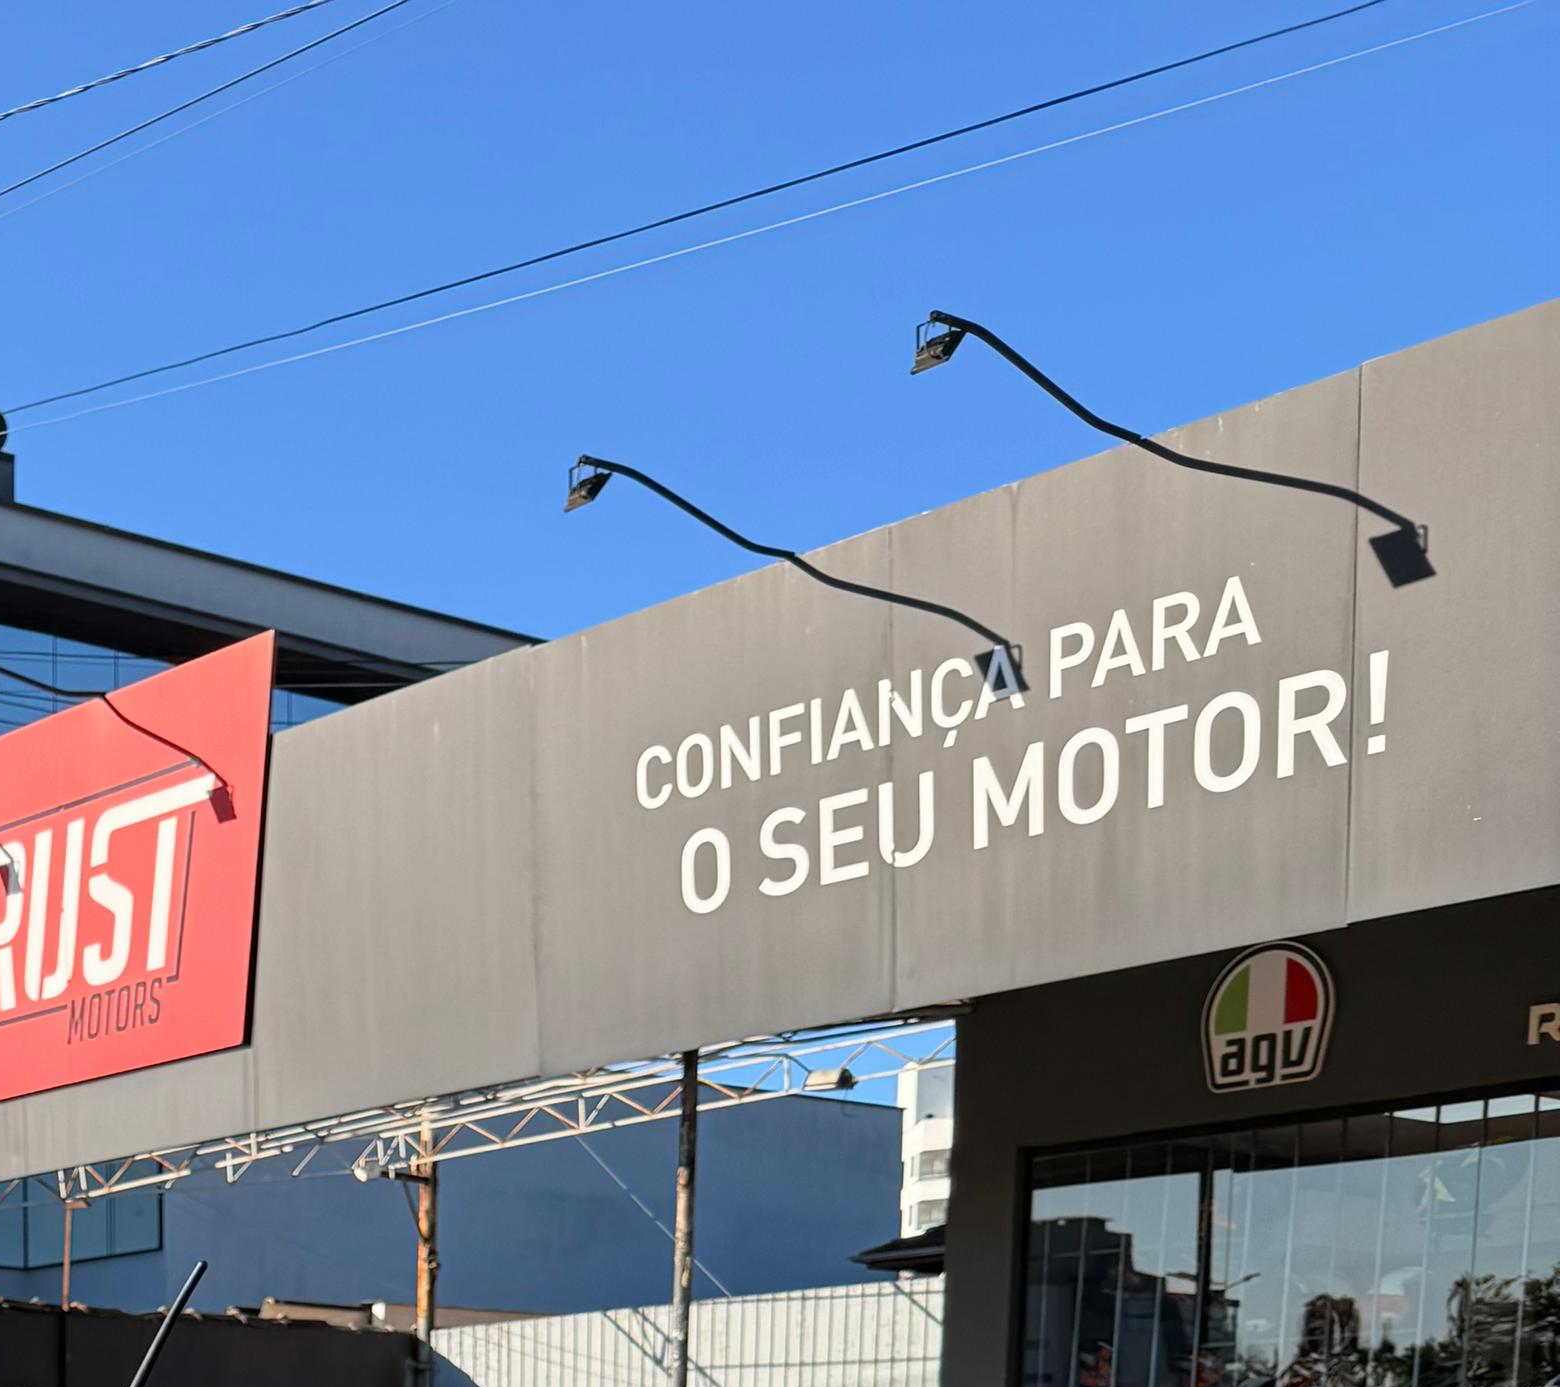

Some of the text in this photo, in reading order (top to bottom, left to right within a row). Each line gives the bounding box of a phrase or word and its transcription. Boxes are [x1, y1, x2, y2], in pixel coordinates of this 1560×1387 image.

[635, 576, 1262, 810] CONFIANÇA PARA
[680, 650, 1392, 915] O SEU MOTOR!
[66, 978, 162, 1046] MOTORS
[1219, 1025, 1314, 1085] agv
